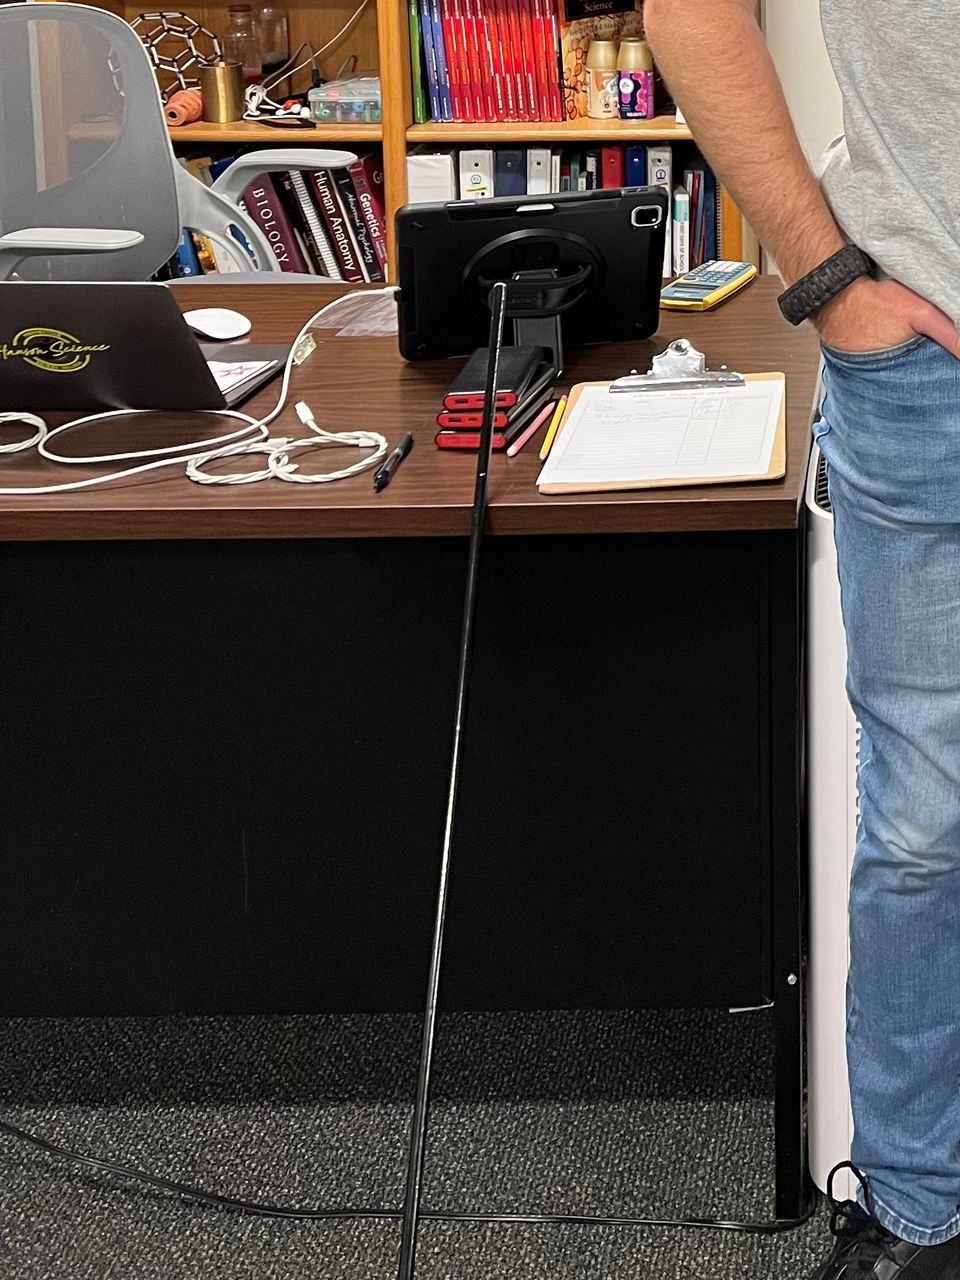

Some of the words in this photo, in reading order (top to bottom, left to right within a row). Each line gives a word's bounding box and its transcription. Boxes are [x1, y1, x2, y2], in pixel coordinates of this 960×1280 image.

[584, 1, 614, 13] Science
[252, 188, 290, 263] BIOLOGY
[314, 170, 337, 214] Human
[329, 216, 356, 271] Anatomy
[360, 193, 381, 238] Genetics
[49, 340, 111, 357] Science
